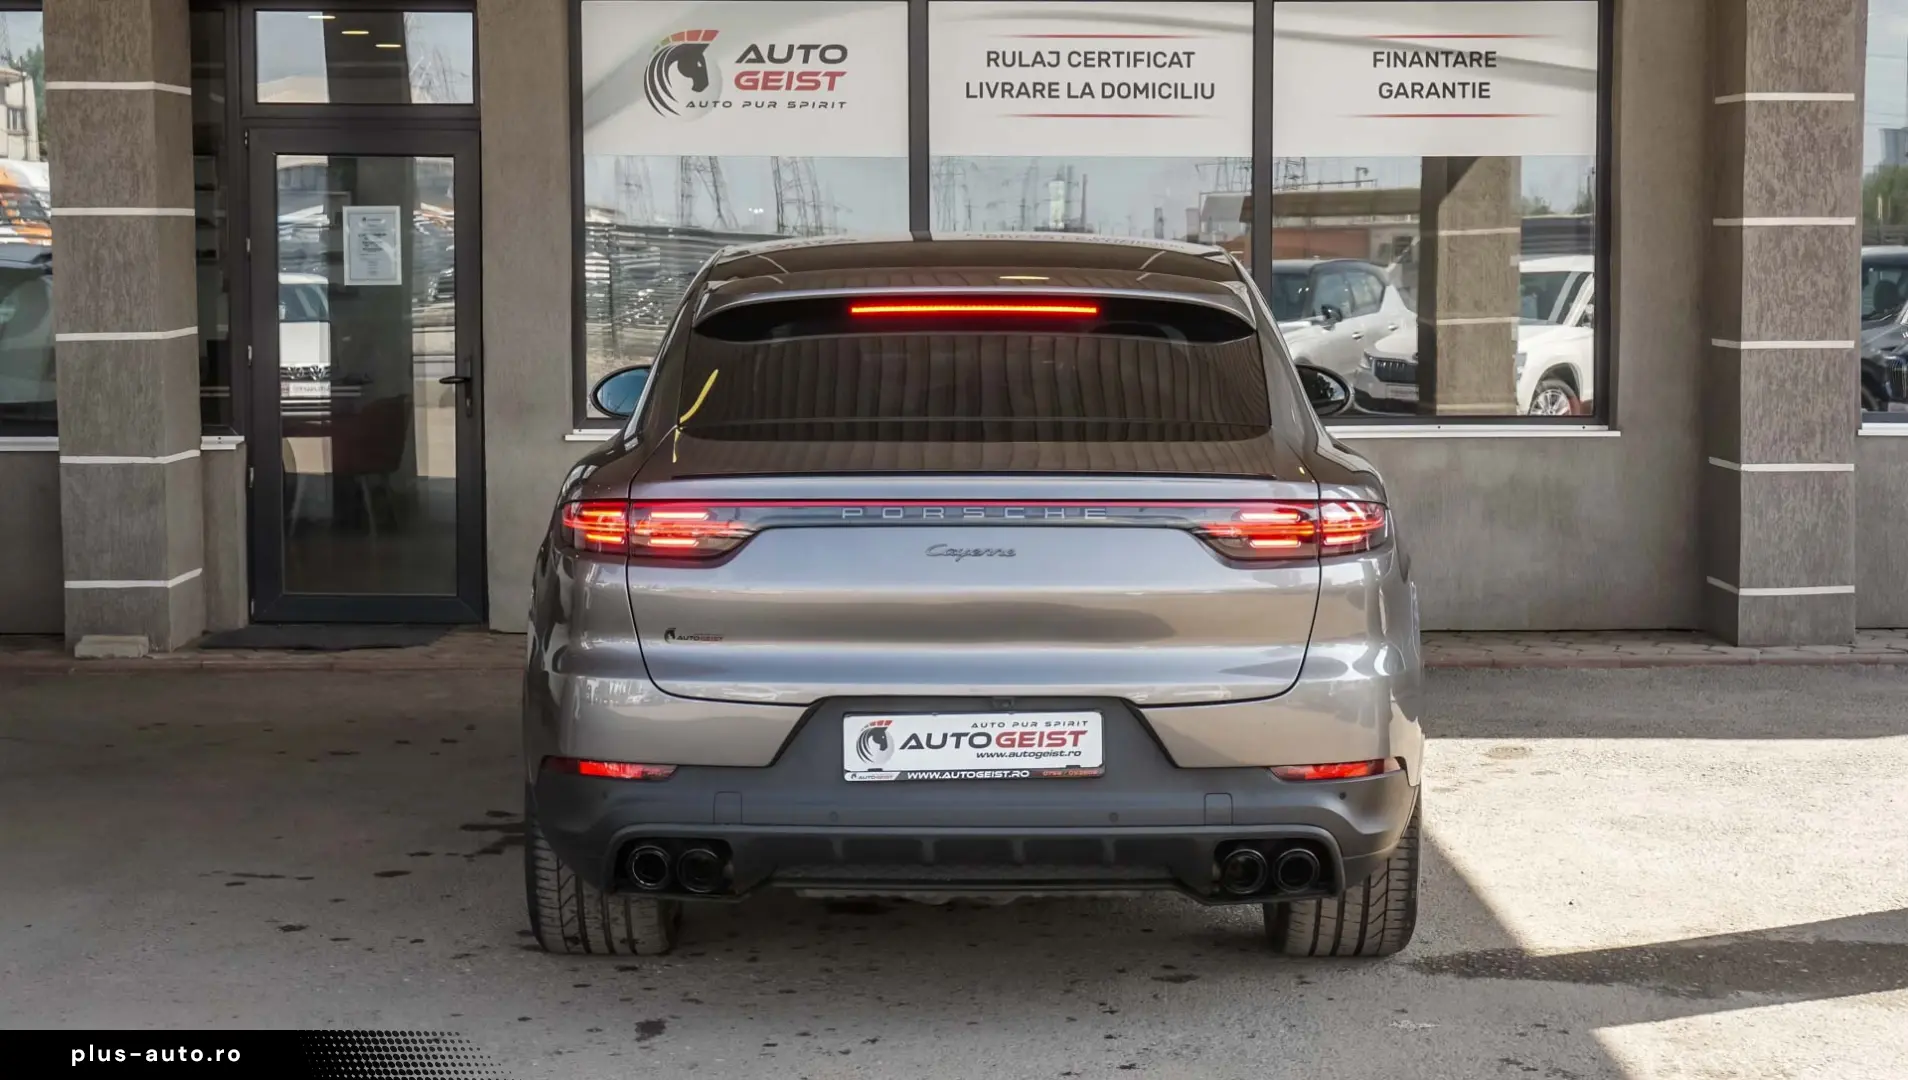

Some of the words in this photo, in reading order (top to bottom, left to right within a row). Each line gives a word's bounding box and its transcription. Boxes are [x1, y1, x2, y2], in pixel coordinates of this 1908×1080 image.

[735, 43, 848, 64] AUTO
[985, 50, 1061, 68] RULAJ
[1067, 51, 1196, 68] CERTIFICAT
[1372, 50, 1498, 68] FINANTARE
[734, 70, 848, 92] GEIST
[1378, 81, 1492, 99] GARANTIE
[965, 81, 1061, 99] LIVRARE
[1066, 82, 1096, 99] LA
[1101, 82, 1216, 100] DOMICILIU
[685, 100, 733, 109] AUTO
[741, 100, 778, 109] PUR
[786, 100, 848, 110] SPIRIT
[841, 506, 1108, 520] PORSCHE
[925, 543, 1017, 562] Cayenne
[970, 721, 1006, 729] AUTO
[1044, 720, 1089, 728] SPIRIT
[899, 729, 1089, 750] AUTOGEIST
[975, 749, 1083, 760] www.autogeist.ro
[906, 769, 1031, 780] WWW.AUTOGEIST.RO
